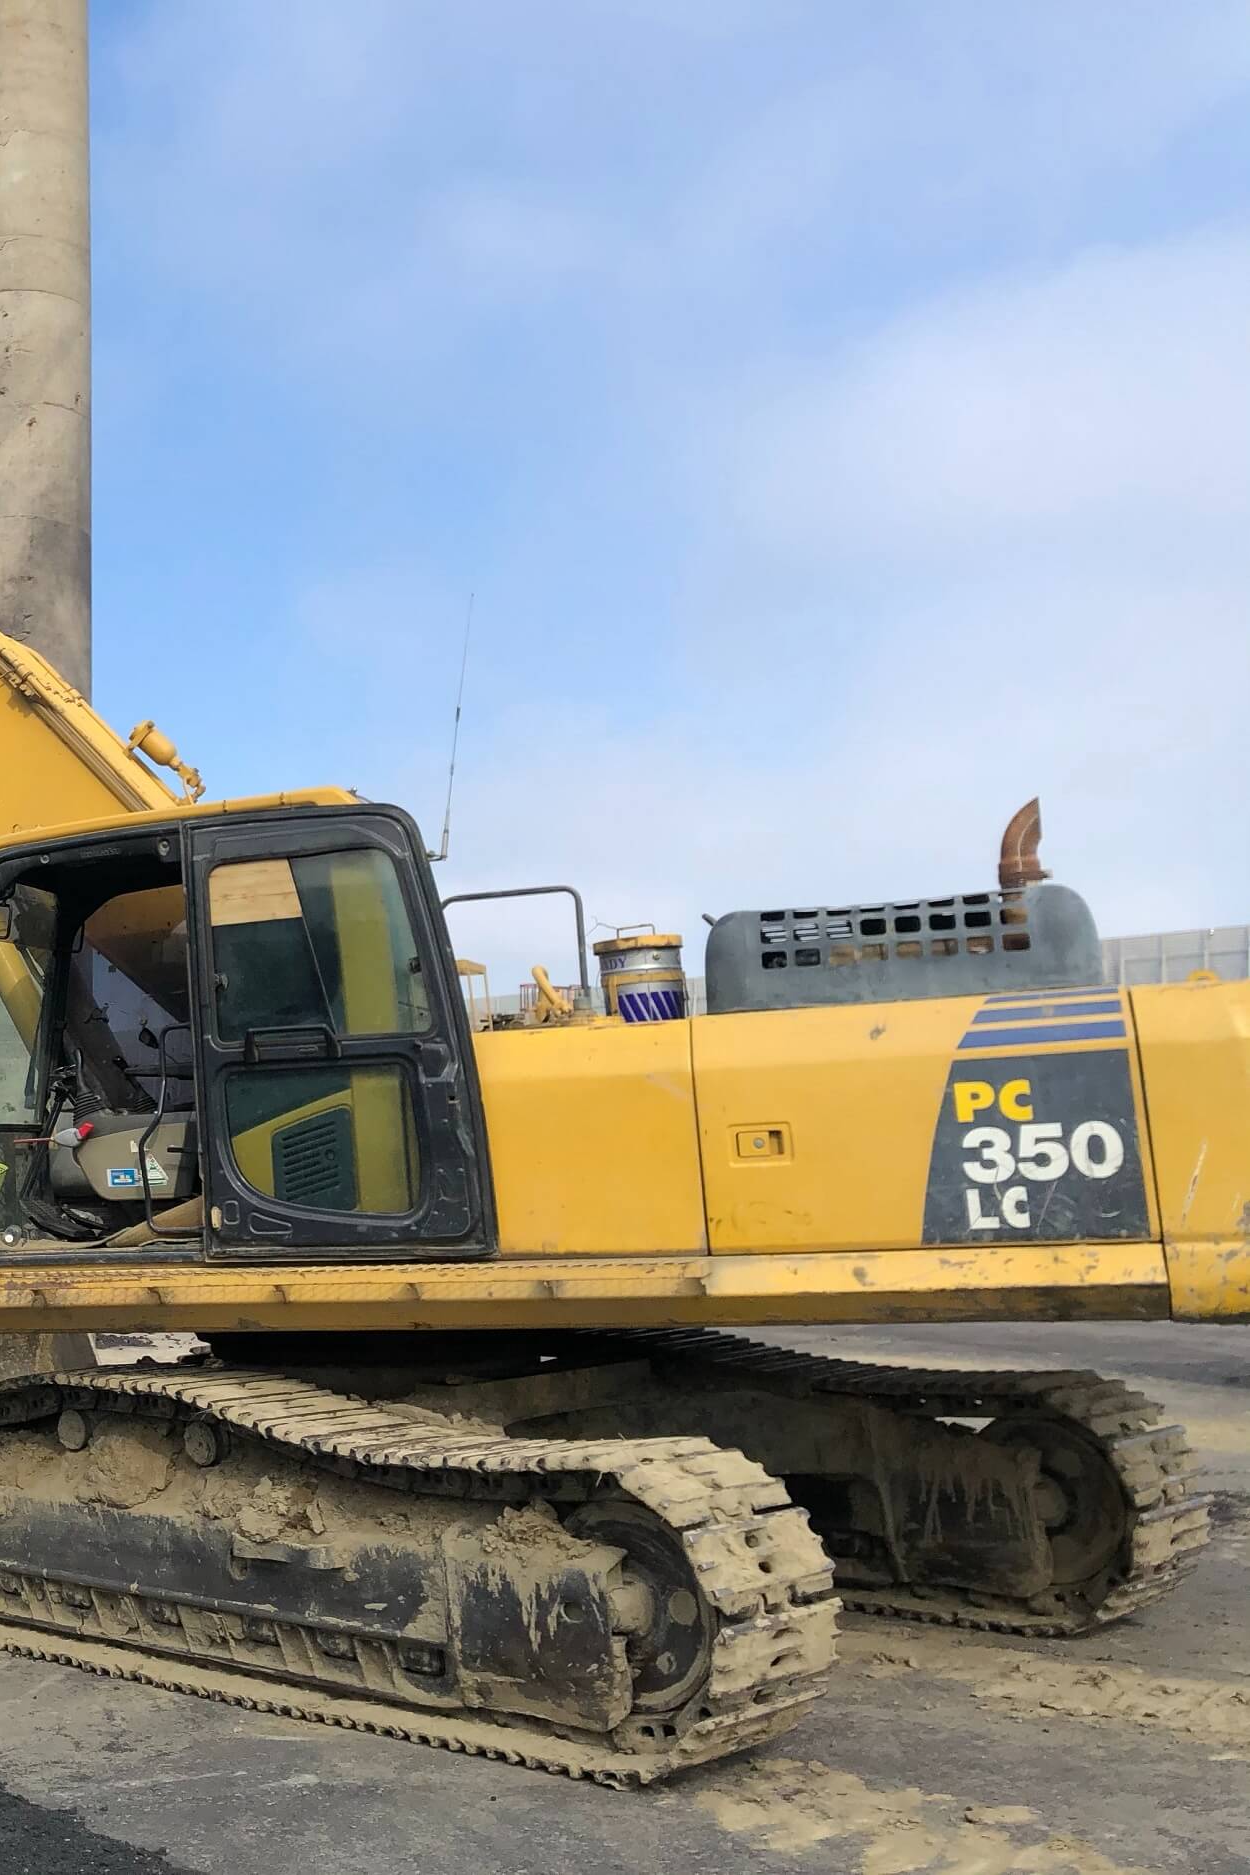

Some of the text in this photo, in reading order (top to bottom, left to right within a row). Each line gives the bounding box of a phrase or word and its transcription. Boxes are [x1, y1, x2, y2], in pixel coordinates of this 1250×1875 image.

[953, 1079, 1034, 1123] PC
[961, 1120, 1124, 1184] 350
[966, 1186, 1031, 1230] LC
